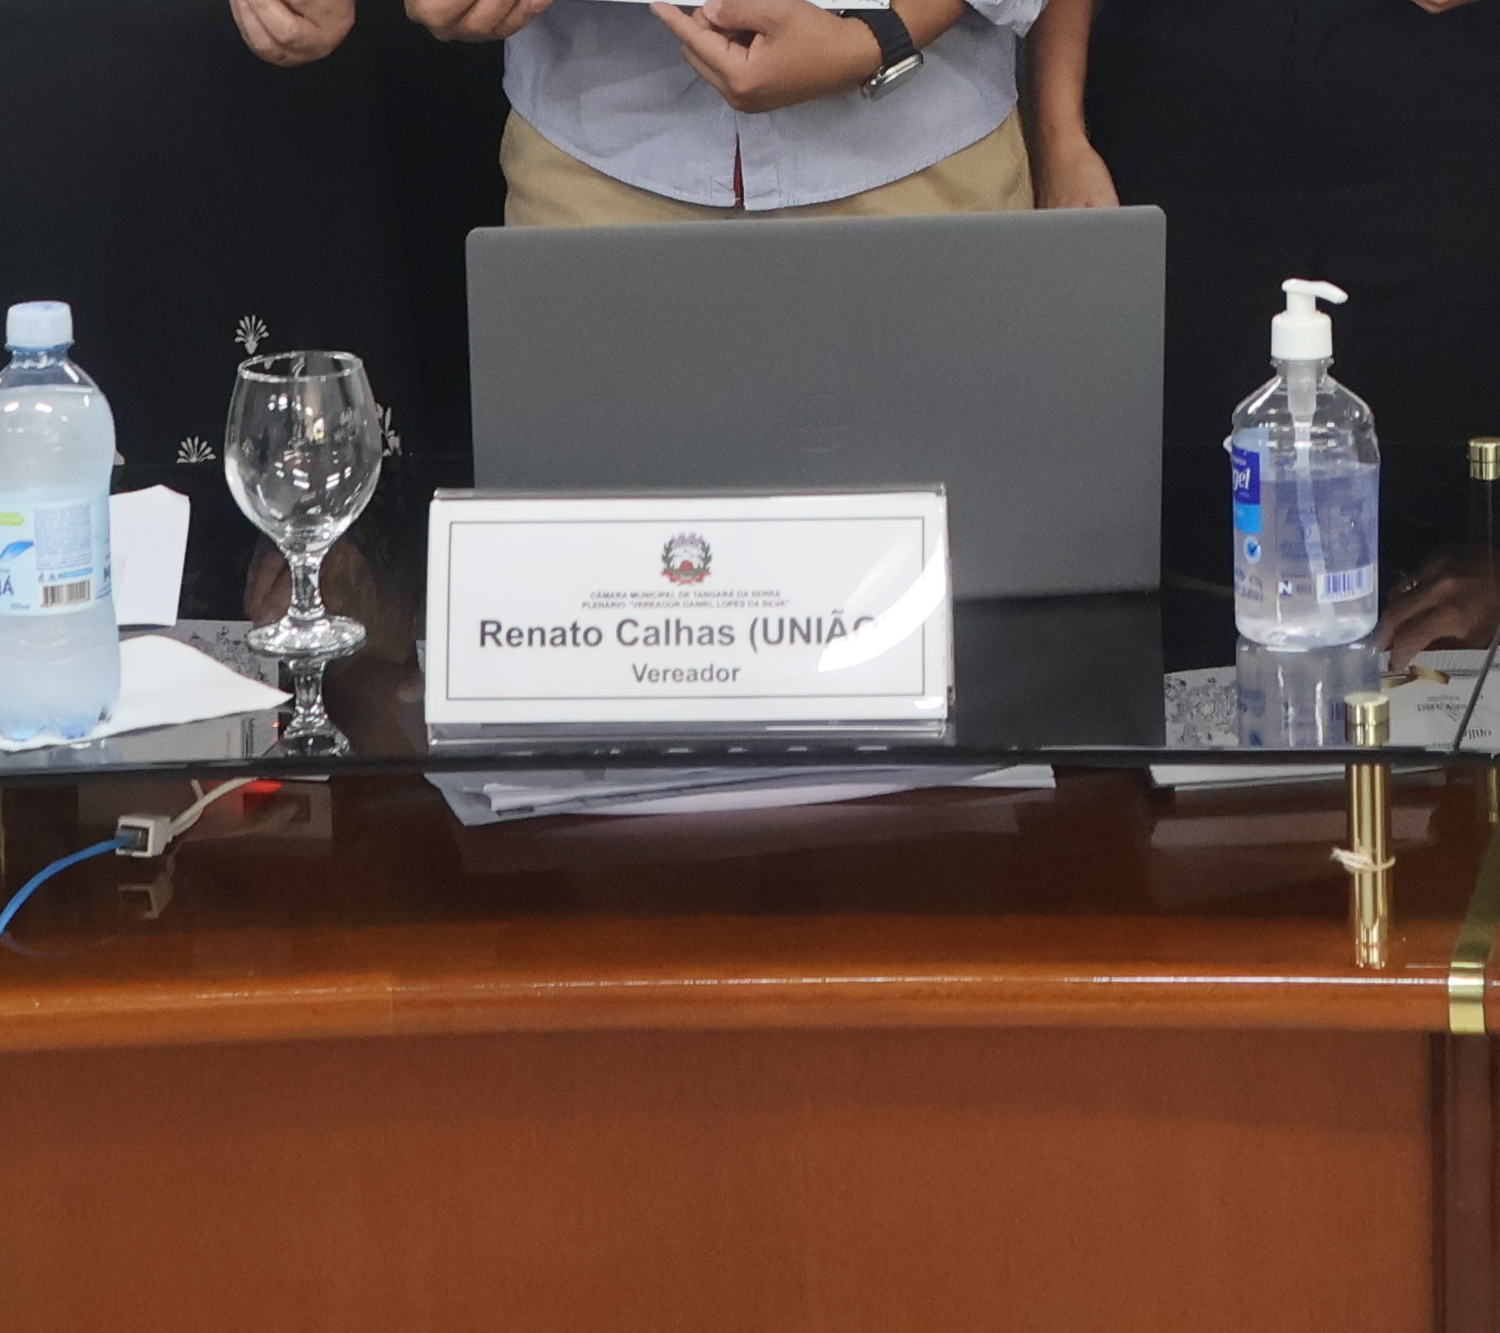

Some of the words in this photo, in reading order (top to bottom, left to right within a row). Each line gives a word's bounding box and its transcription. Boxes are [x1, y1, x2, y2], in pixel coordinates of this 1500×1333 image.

[479, 619, 603, 648] Renato
[616, 617, 735, 646] Calhas
[632, 663, 741, 684] Vereador
